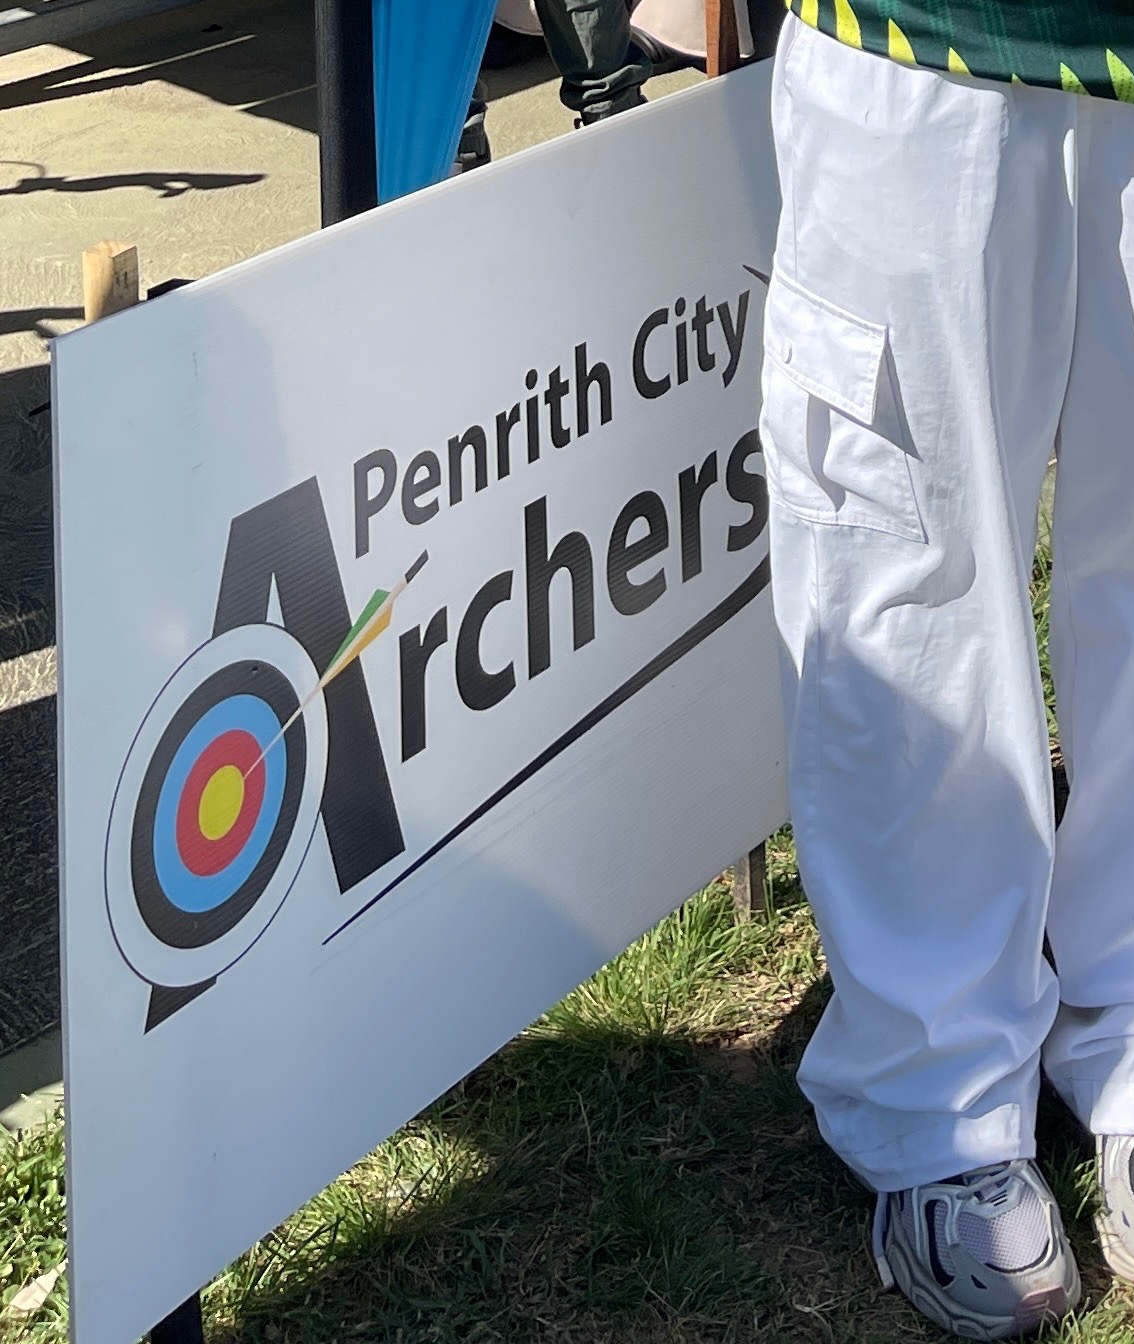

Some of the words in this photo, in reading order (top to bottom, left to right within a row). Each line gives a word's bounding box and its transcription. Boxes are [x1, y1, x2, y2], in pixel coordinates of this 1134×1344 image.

[353, 341, 613, 559] Penrith
[631, 288, 752, 389] City
[143, 427, 771, 1036] Archers
